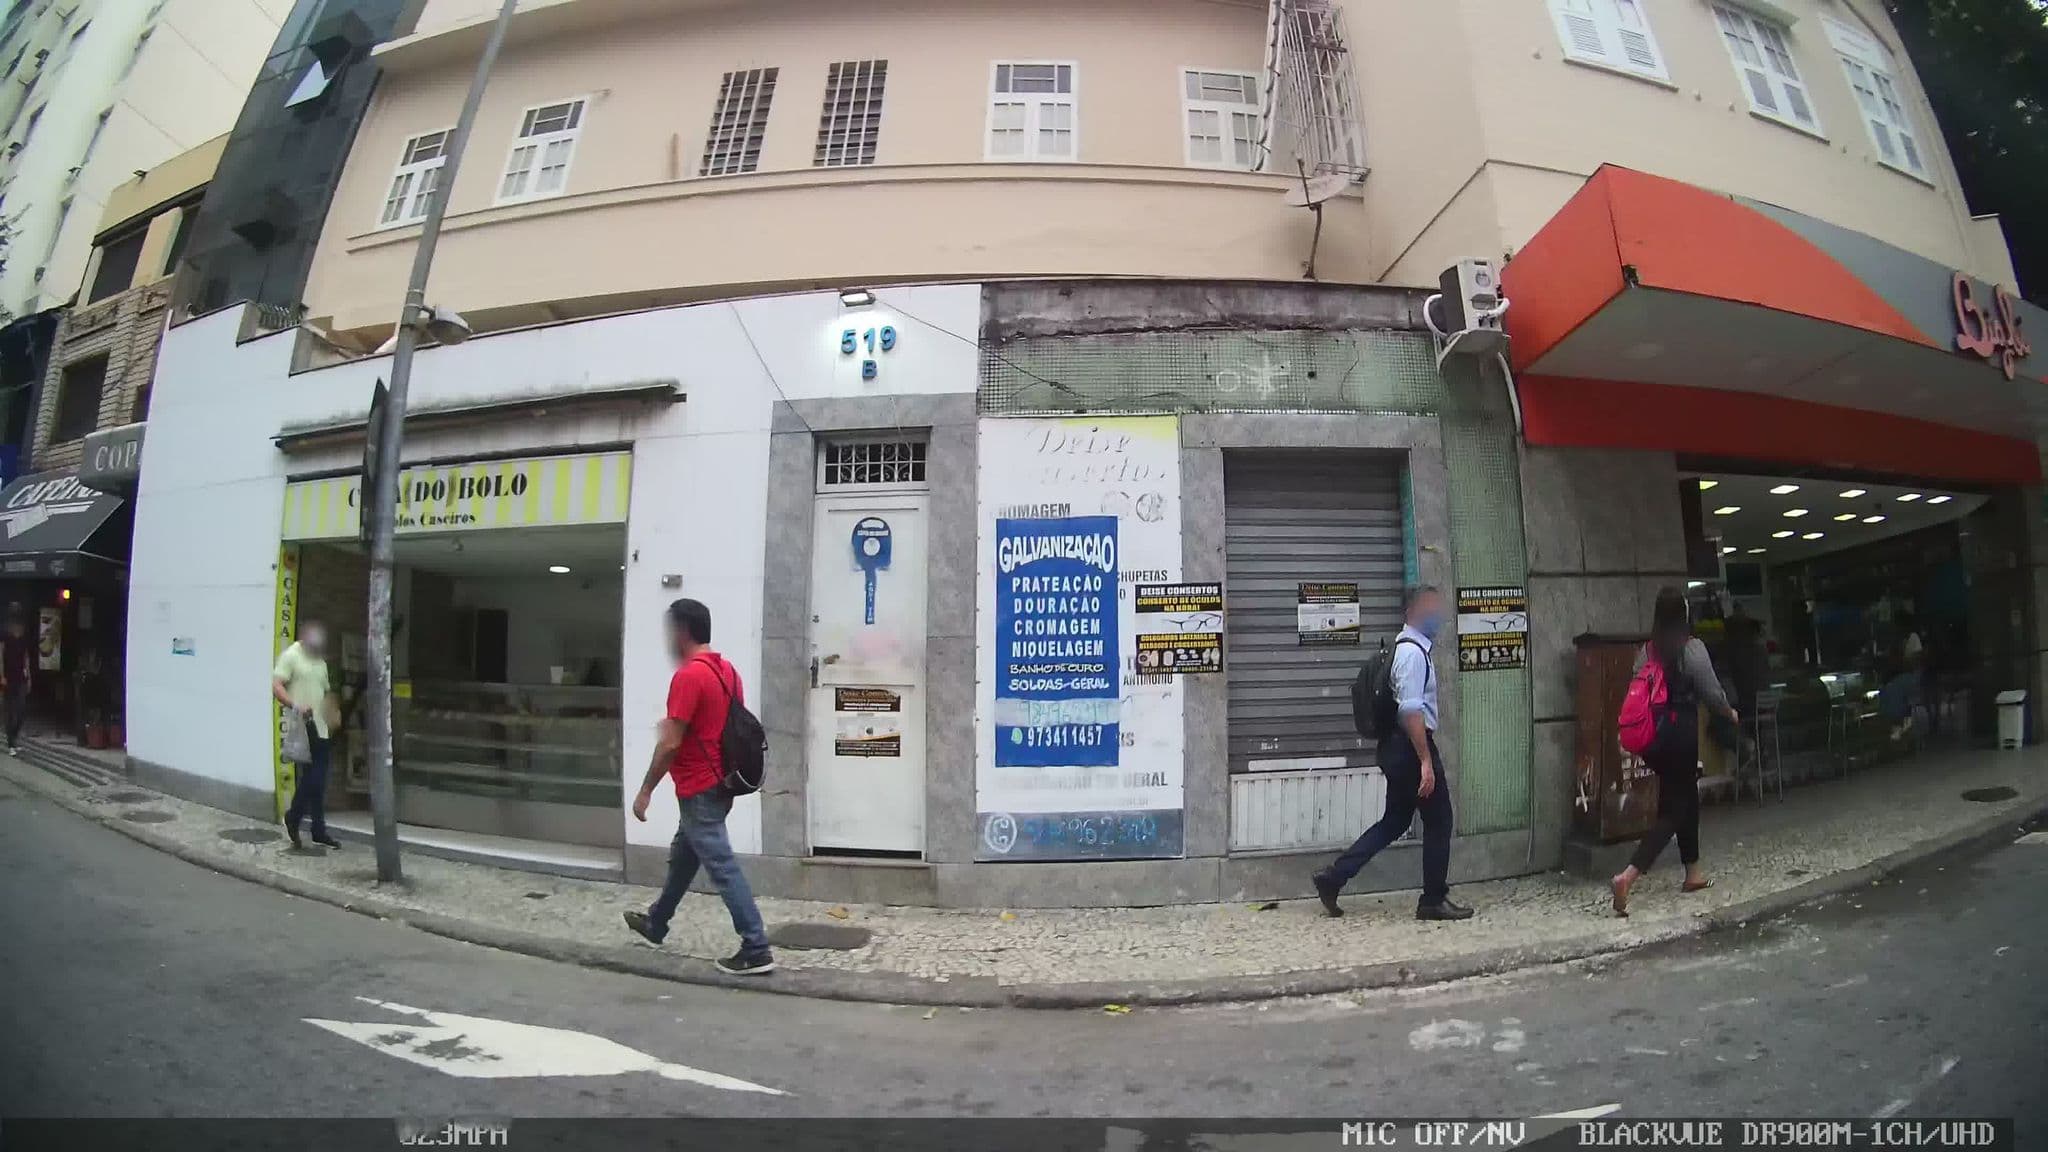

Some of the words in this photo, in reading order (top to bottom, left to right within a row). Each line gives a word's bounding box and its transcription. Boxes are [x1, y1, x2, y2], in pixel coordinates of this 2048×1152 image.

[841, 325, 896, 354] 519
[862, 359, 877, 379] B
[95, 440, 139, 471] COP
[414, 478, 446, 502] DO
[459, 472, 528, 499] BOLO
[420, 512, 476, 526] Caseiros
[999, 533, 1115, 573] GALVANIZAÇÃO
[1012, 574, 1102, 593] PRATEAÇÃO
[1117, 570, 1168, 583] HUPETAS
[281, 577, 292, 638] CASA
[1014, 596, 1101, 616] DOURAÇÃO
[1014, 618, 1101, 636] CROMAGEM
[1012, 640, 1104, 660] NIQUELAGEM
[1010, 665, 1053, 675] BANHO
